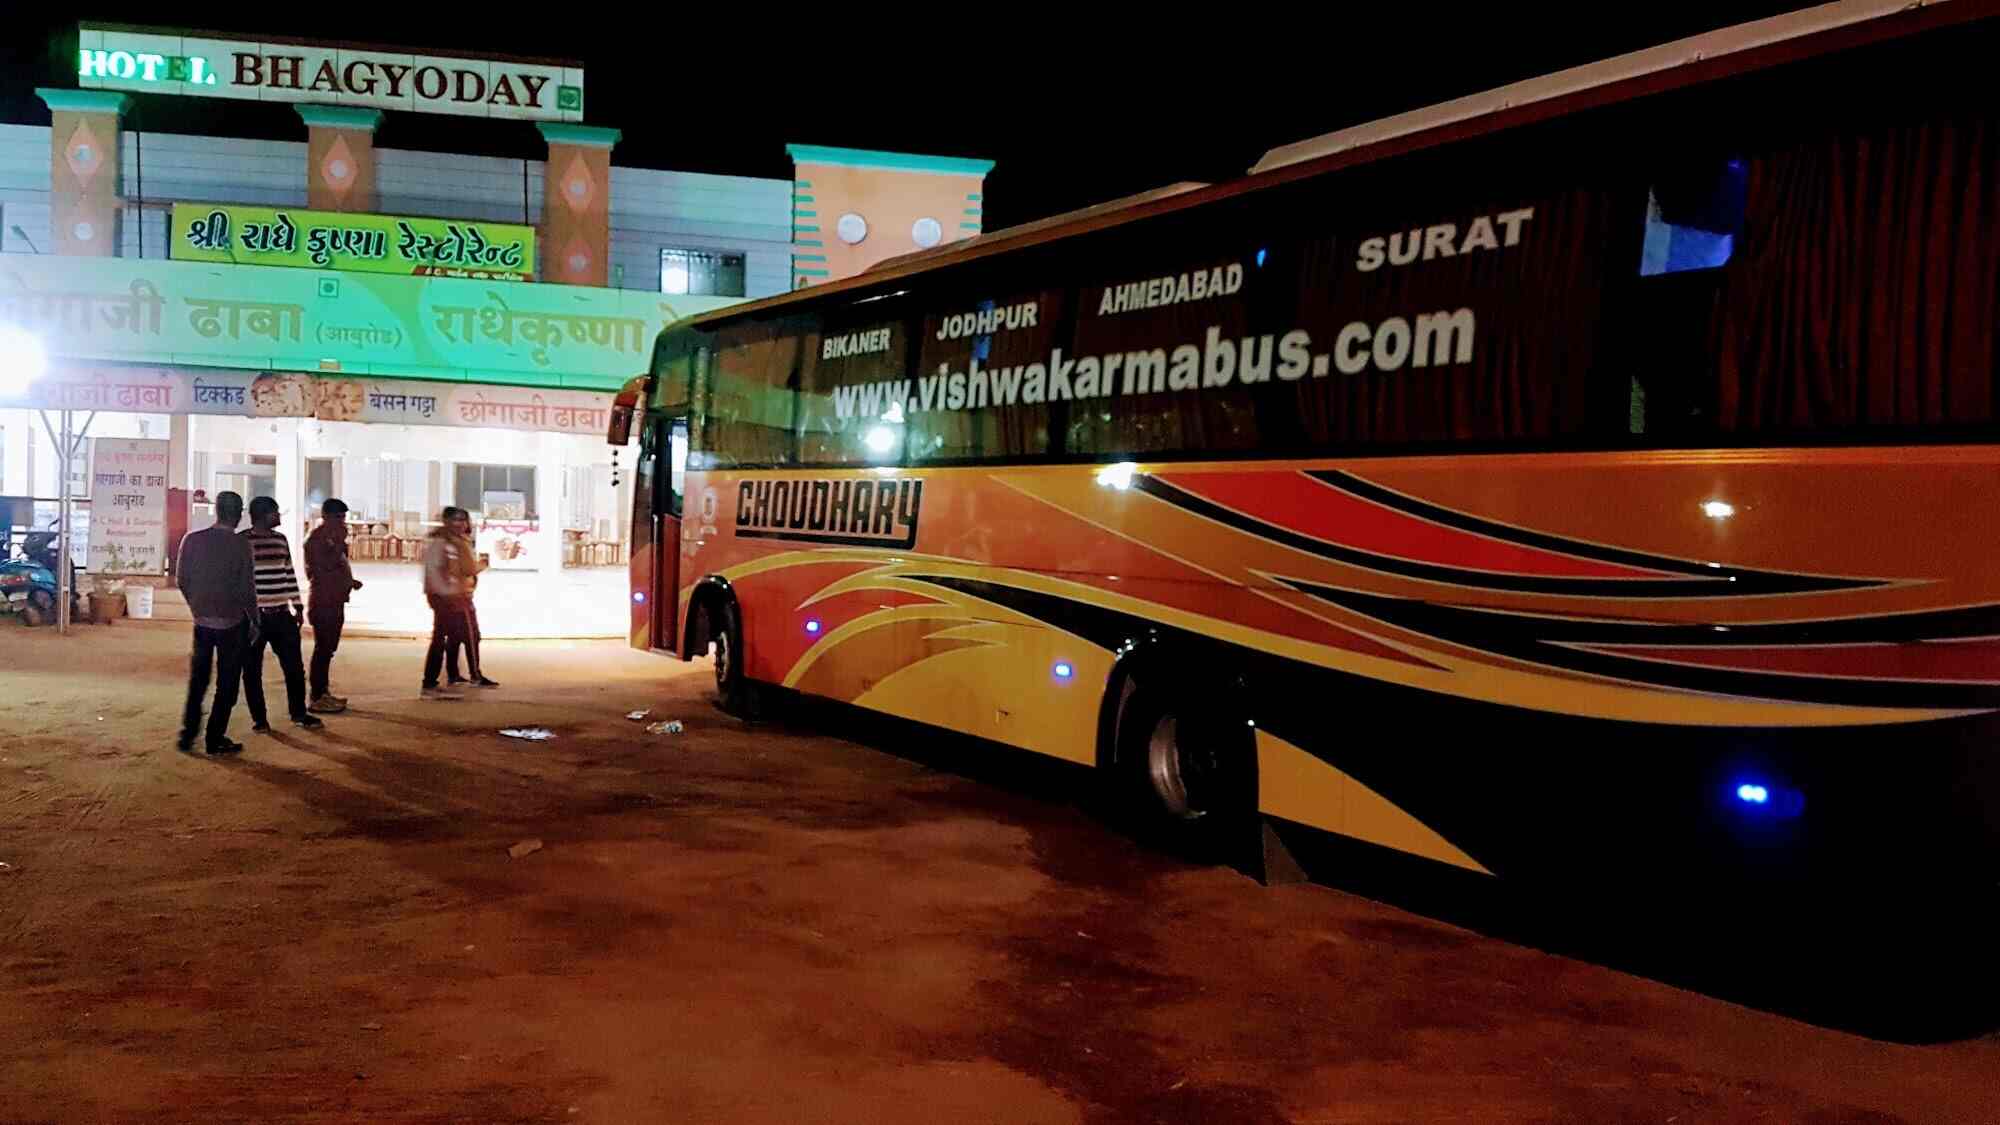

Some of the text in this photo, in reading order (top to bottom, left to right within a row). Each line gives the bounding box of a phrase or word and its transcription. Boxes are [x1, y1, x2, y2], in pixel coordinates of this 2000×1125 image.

[79, 49, 550, 108] HOTEL BHAGYODAY
[187, 211, 230, 250] શ્રી
[241, 213, 297, 252] રાધે
[307, 227, 385, 267] કૃષ્ણા
[1355, 206, 1535, 273] SURAT
[1098, 263, 1243, 316] AHMEDABAD
[184, 297, 304, 342] ढाबा
[822, 327, 892, 360] BIKANER
[935, 301, 1039, 341] JODHPUR
[831, 306, 1477, 419] www.vishwakarmabus.com
[735, 478, 926, 550] CHOUDHARY
